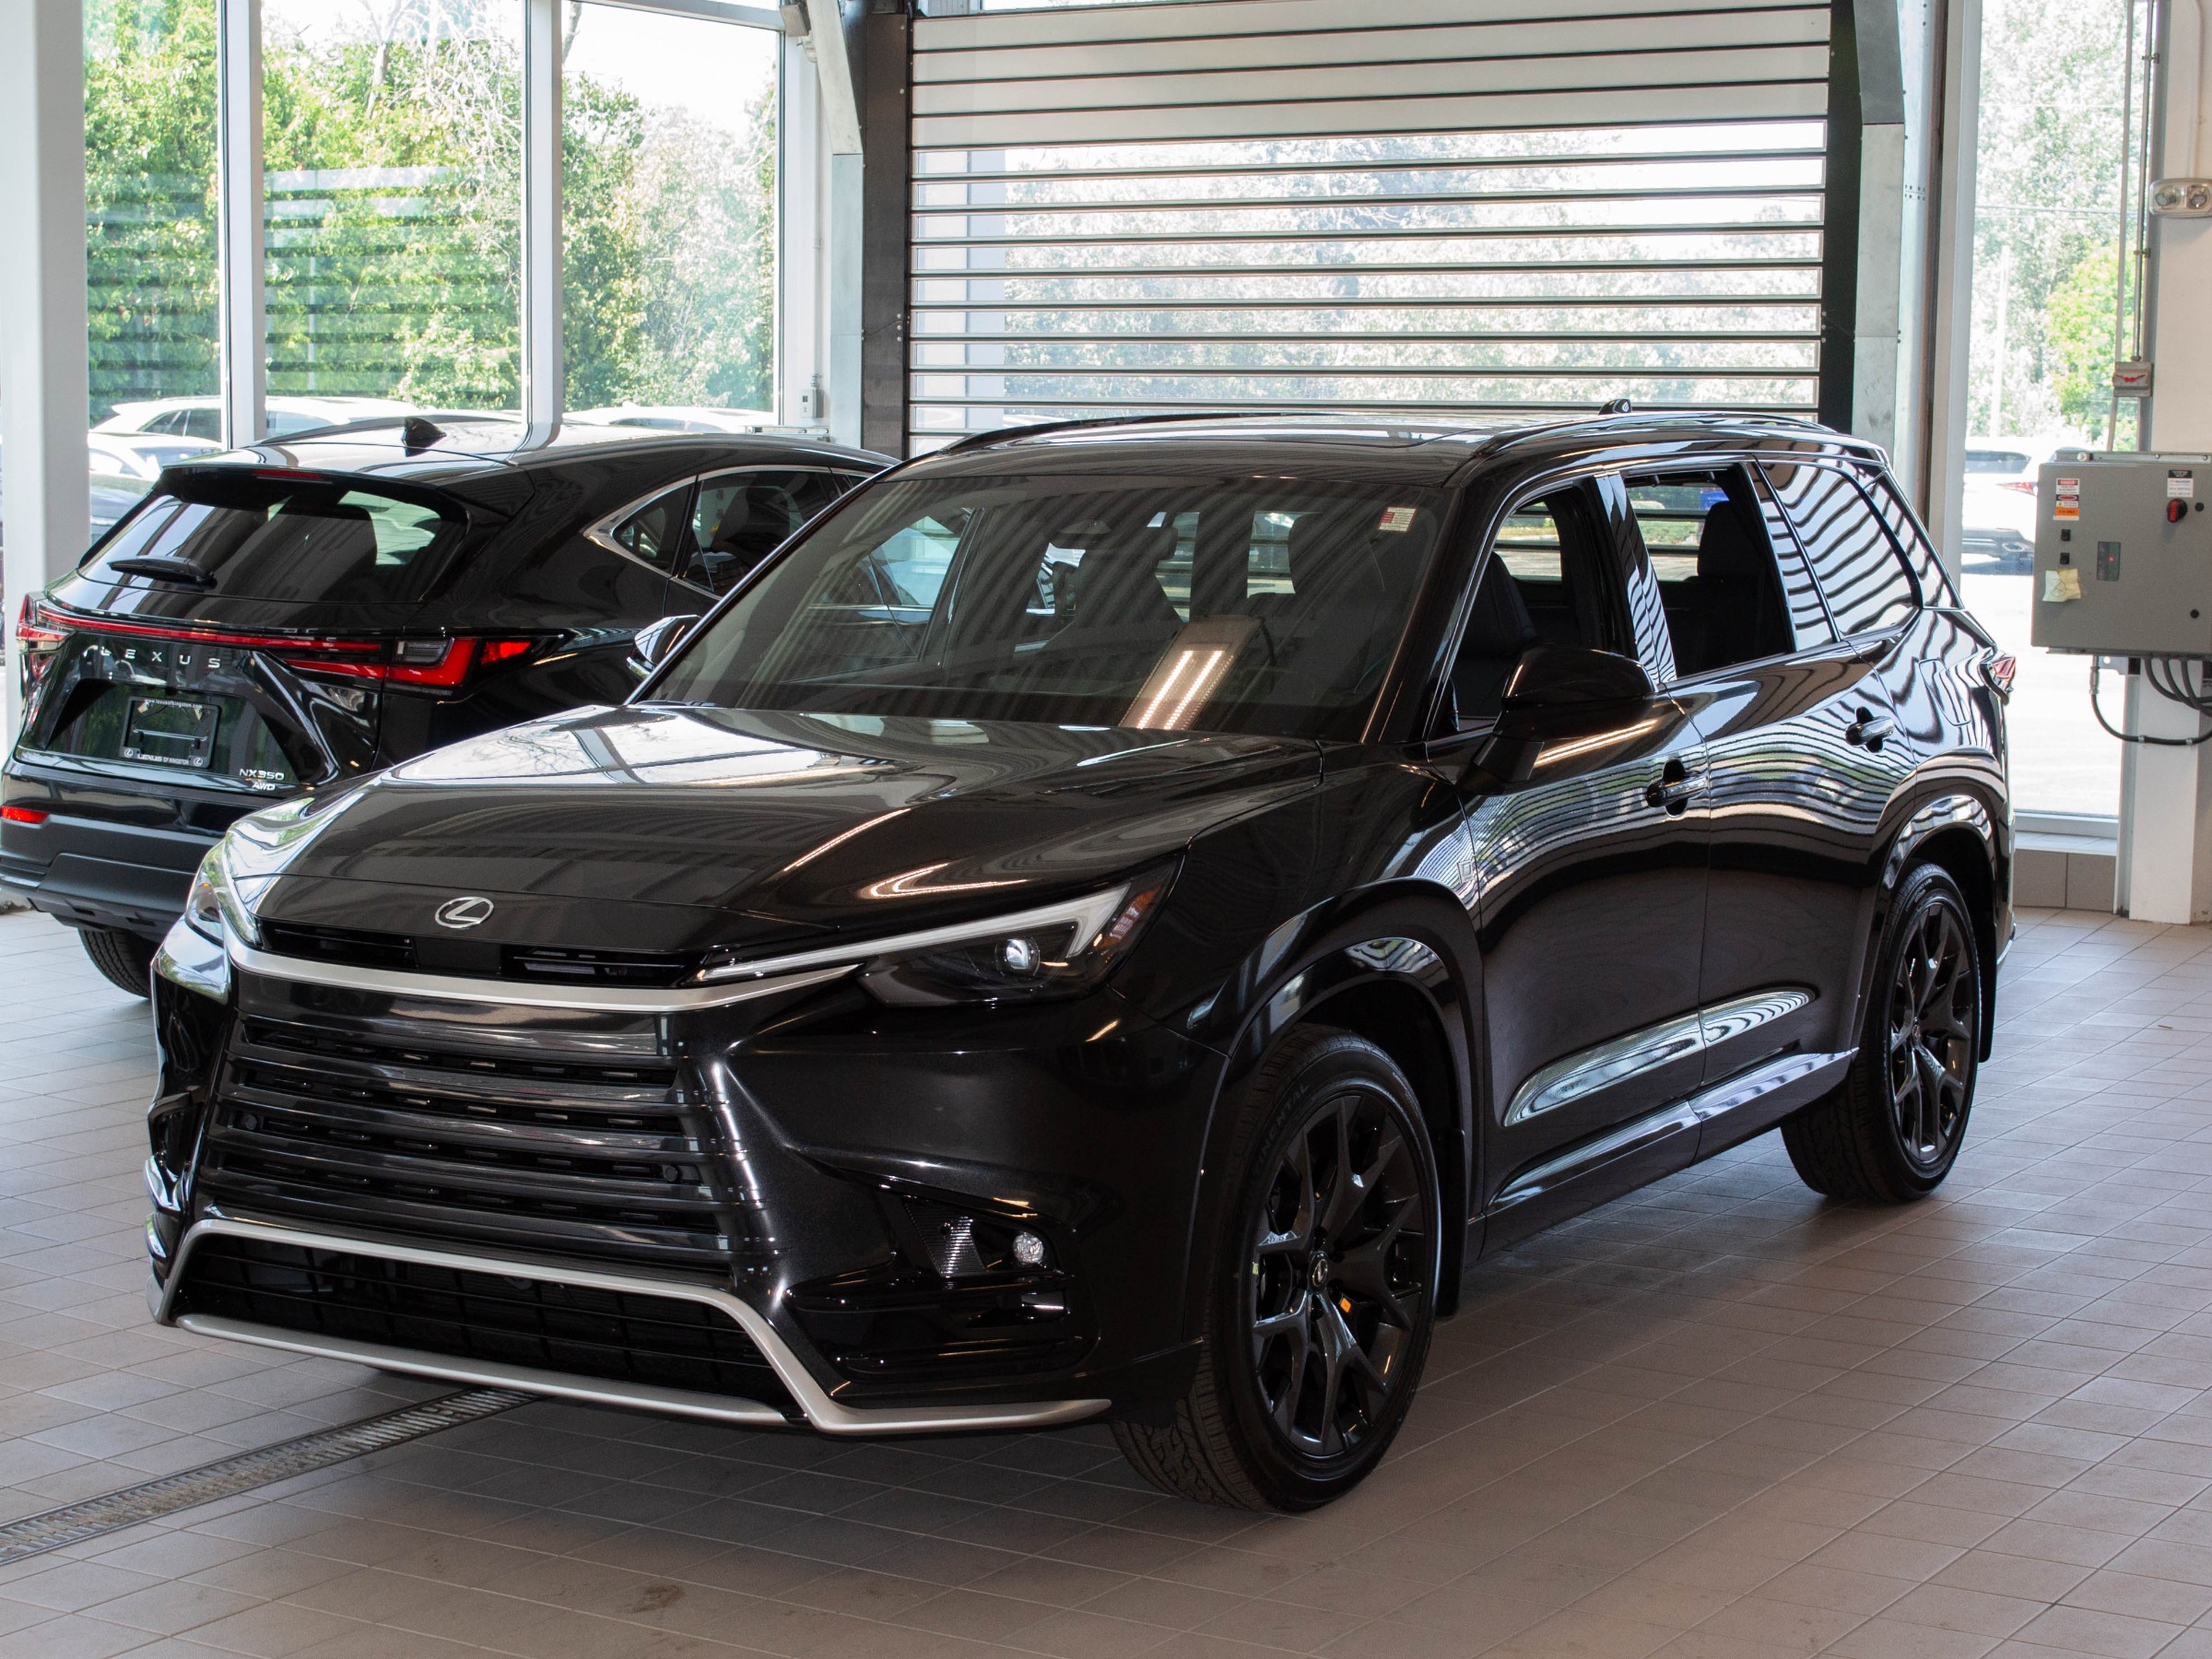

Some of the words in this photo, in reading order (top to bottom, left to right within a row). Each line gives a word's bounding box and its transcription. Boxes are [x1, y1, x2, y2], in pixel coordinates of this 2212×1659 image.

[100, 646, 221, 668] LEXUS
[137, 753, 162, 762] LEXUS
[239, 768, 285, 781] NX350
[252, 782, 276, 792] AWD
